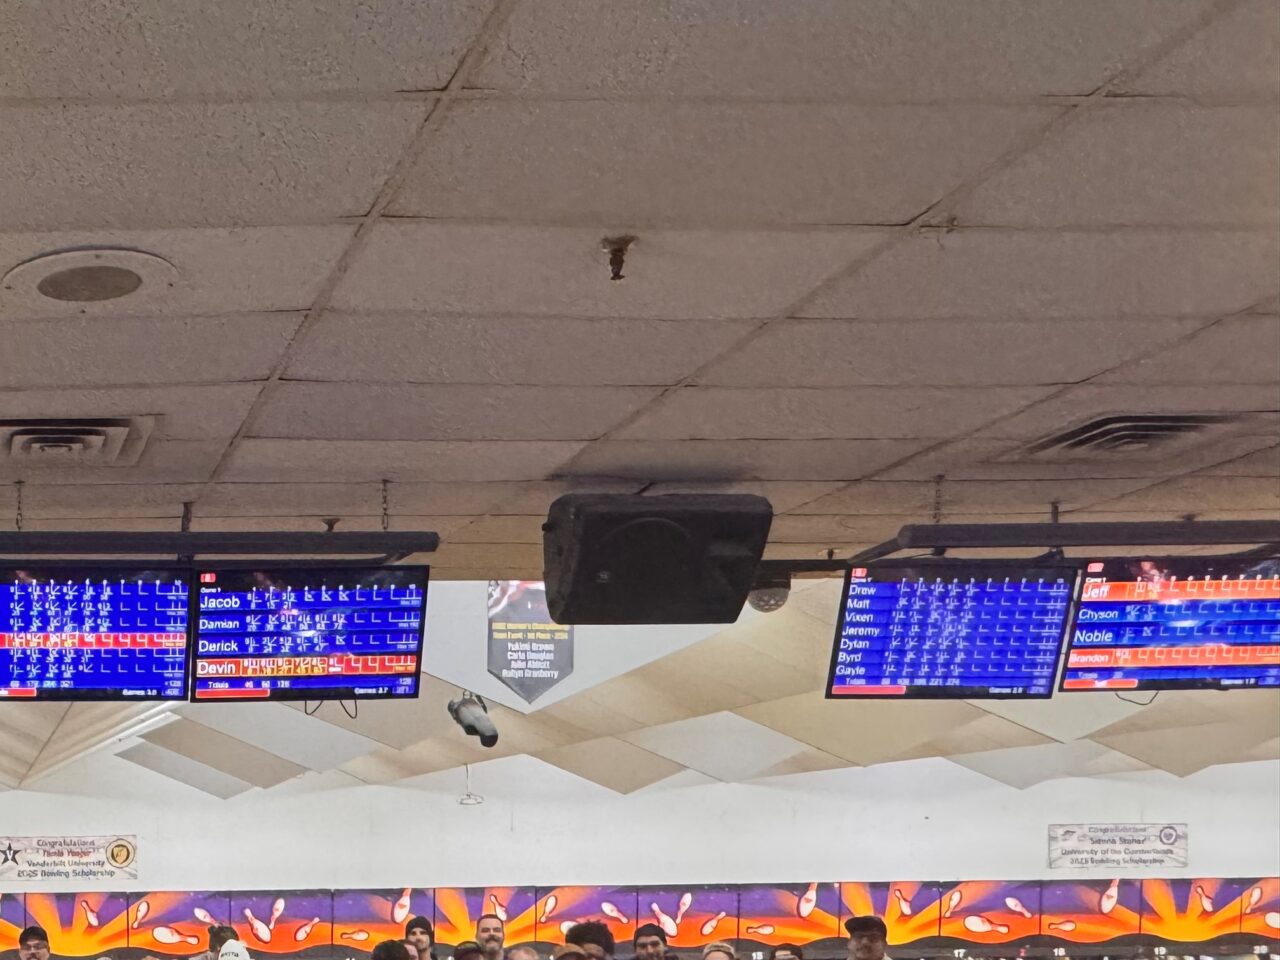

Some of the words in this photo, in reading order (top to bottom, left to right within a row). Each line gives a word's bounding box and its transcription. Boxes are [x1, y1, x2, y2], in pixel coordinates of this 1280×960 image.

[1083, 584, 1110, 597] Jeff
[200, 595, 240, 609] Jacob
[1079, 609, 1118, 620] Chyson
[200, 619, 239, 630] Damian
[1074, 630, 1113, 642] Noble
[199, 640, 238, 652] Derick
[197, 662, 235, 674] Devin
[41, 870, 69, 879] Bowling
[72, 869, 115, 878] Scholarship
